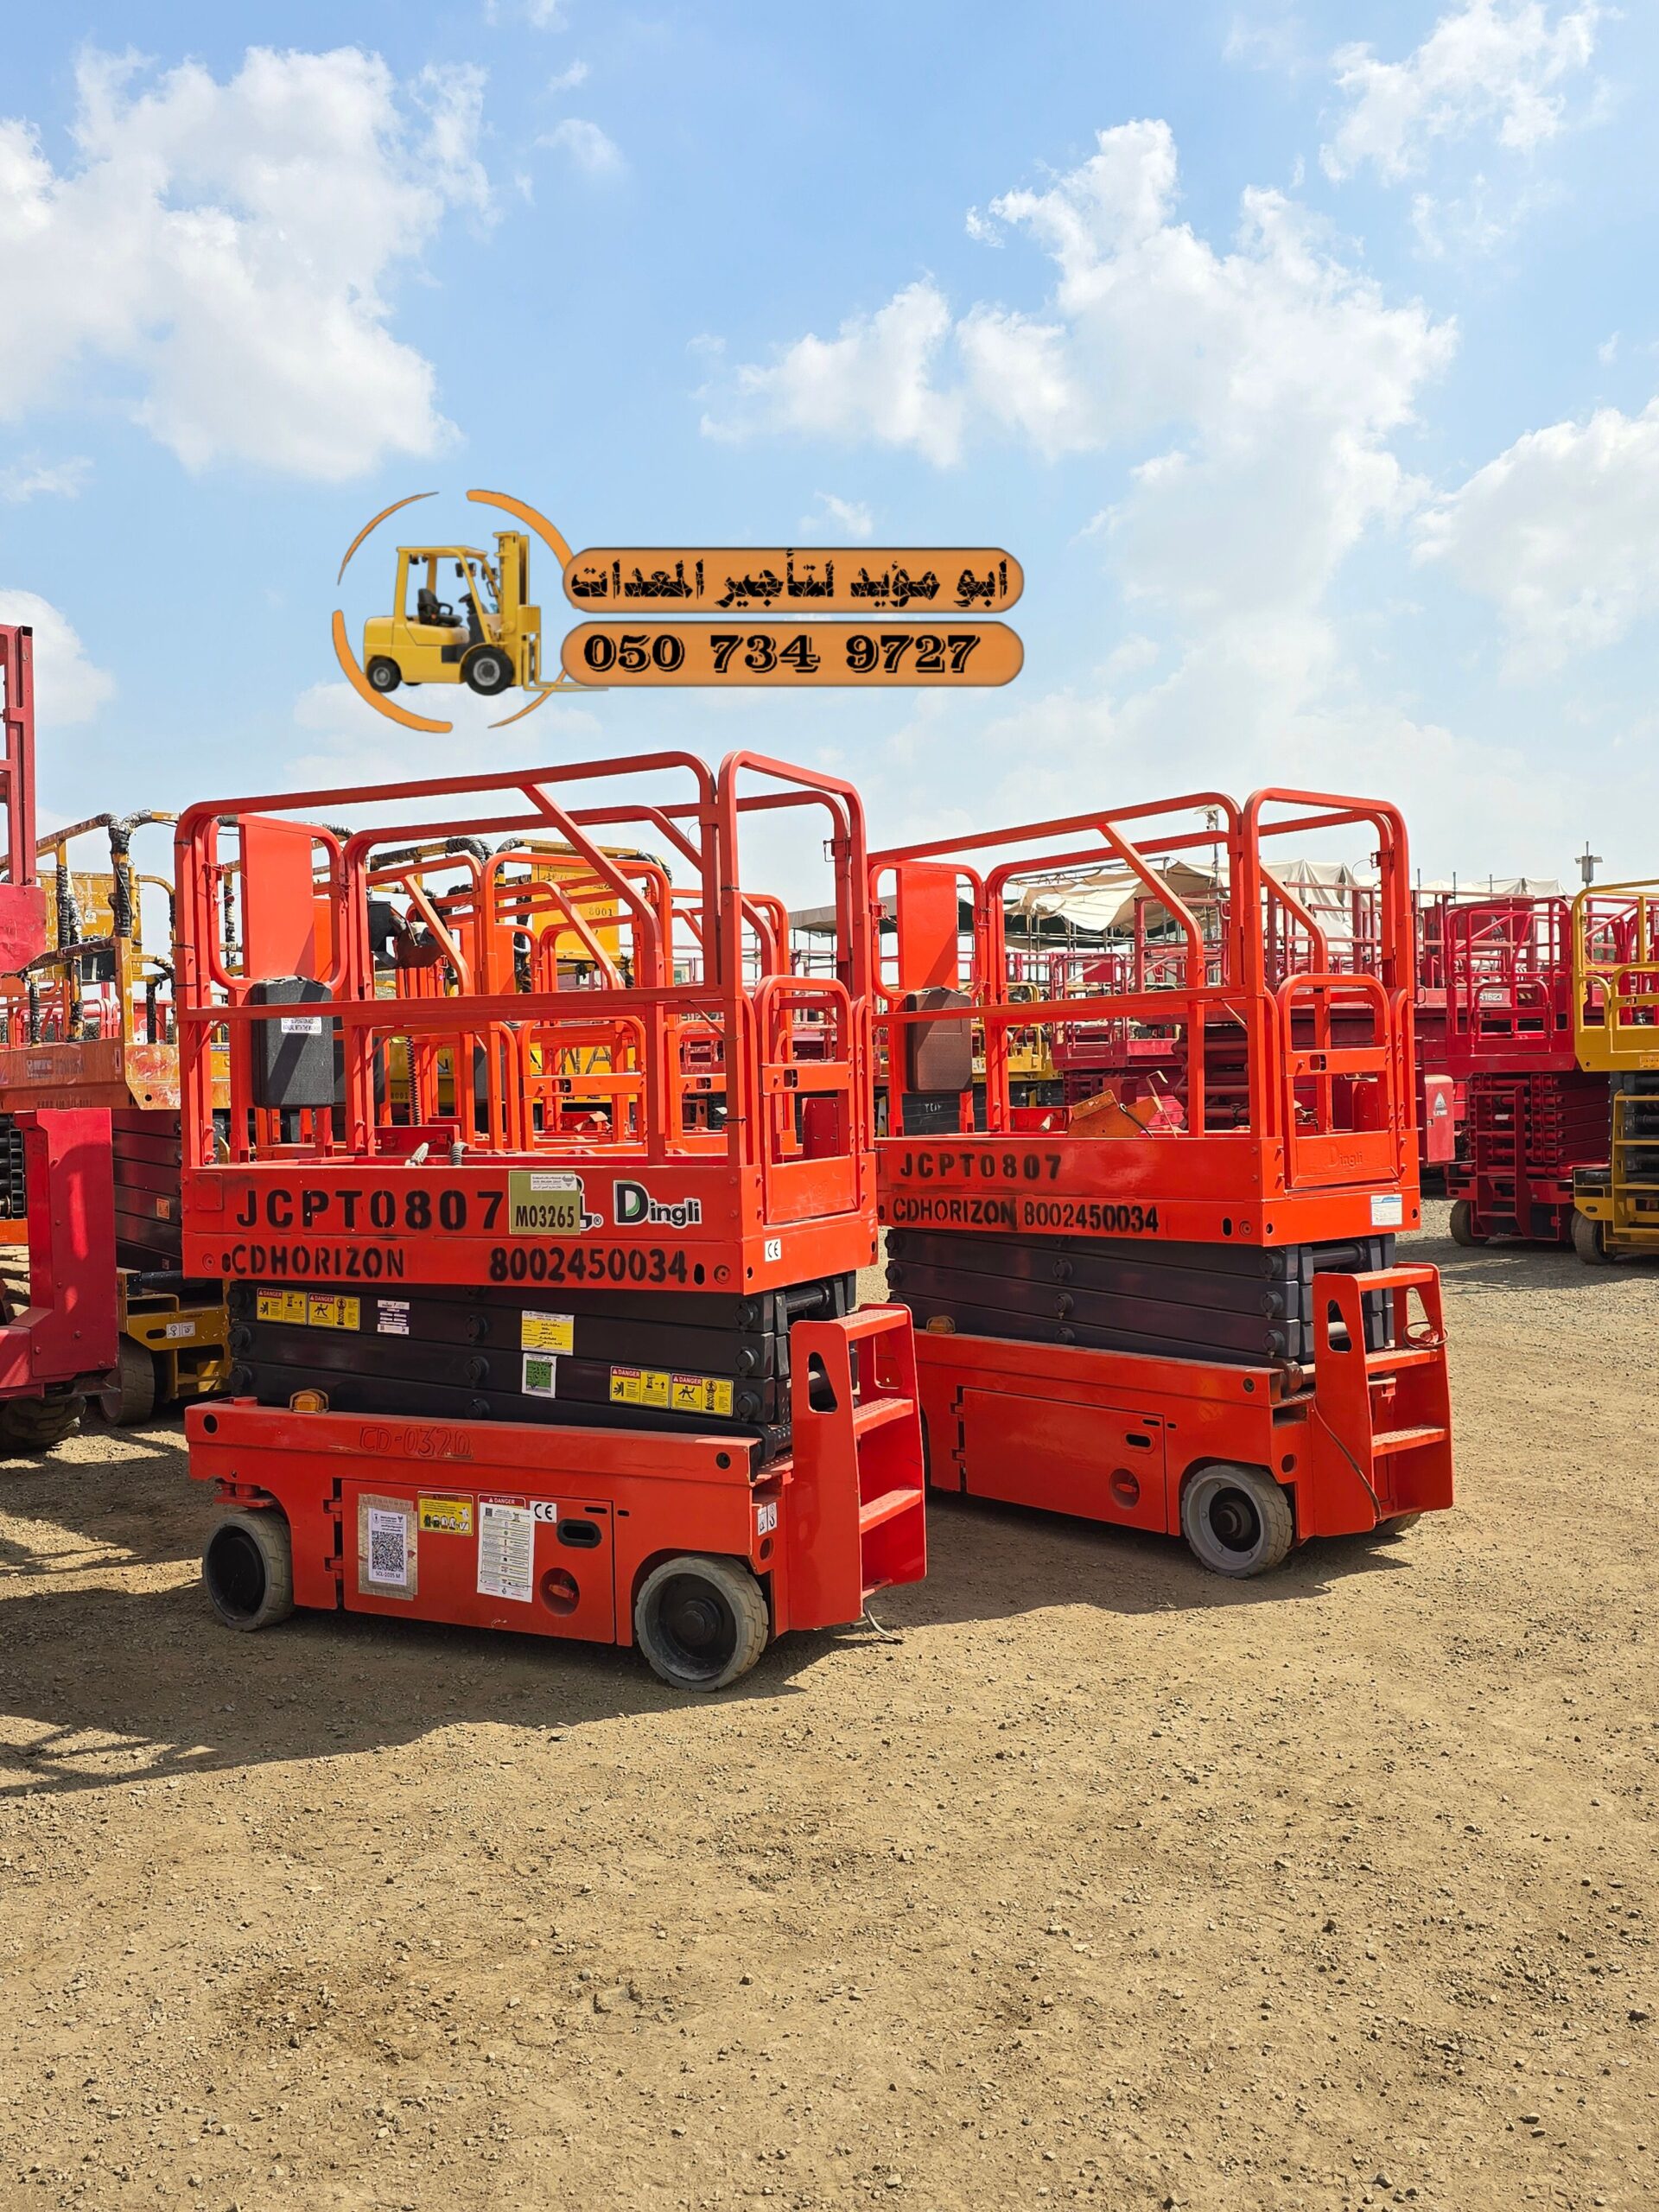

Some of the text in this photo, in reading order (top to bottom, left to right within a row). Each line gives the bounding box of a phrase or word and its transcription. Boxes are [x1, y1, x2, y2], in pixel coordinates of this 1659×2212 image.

[899, 1153, 1062, 1180] JCPT0807
[236, 1189, 504, 1229] JCPT0807
[615, 1182, 700, 1227] Dingli
[893, 1198, 1160, 1234] CDHORIZON 8002450034
[231, 1243, 688, 1283] CDHORIZON 8002450034
[618, 1368, 640, 1377] DANGER
[678, 1375, 702, 1384] DANGER
[534, 1503, 553, 1521] CE
